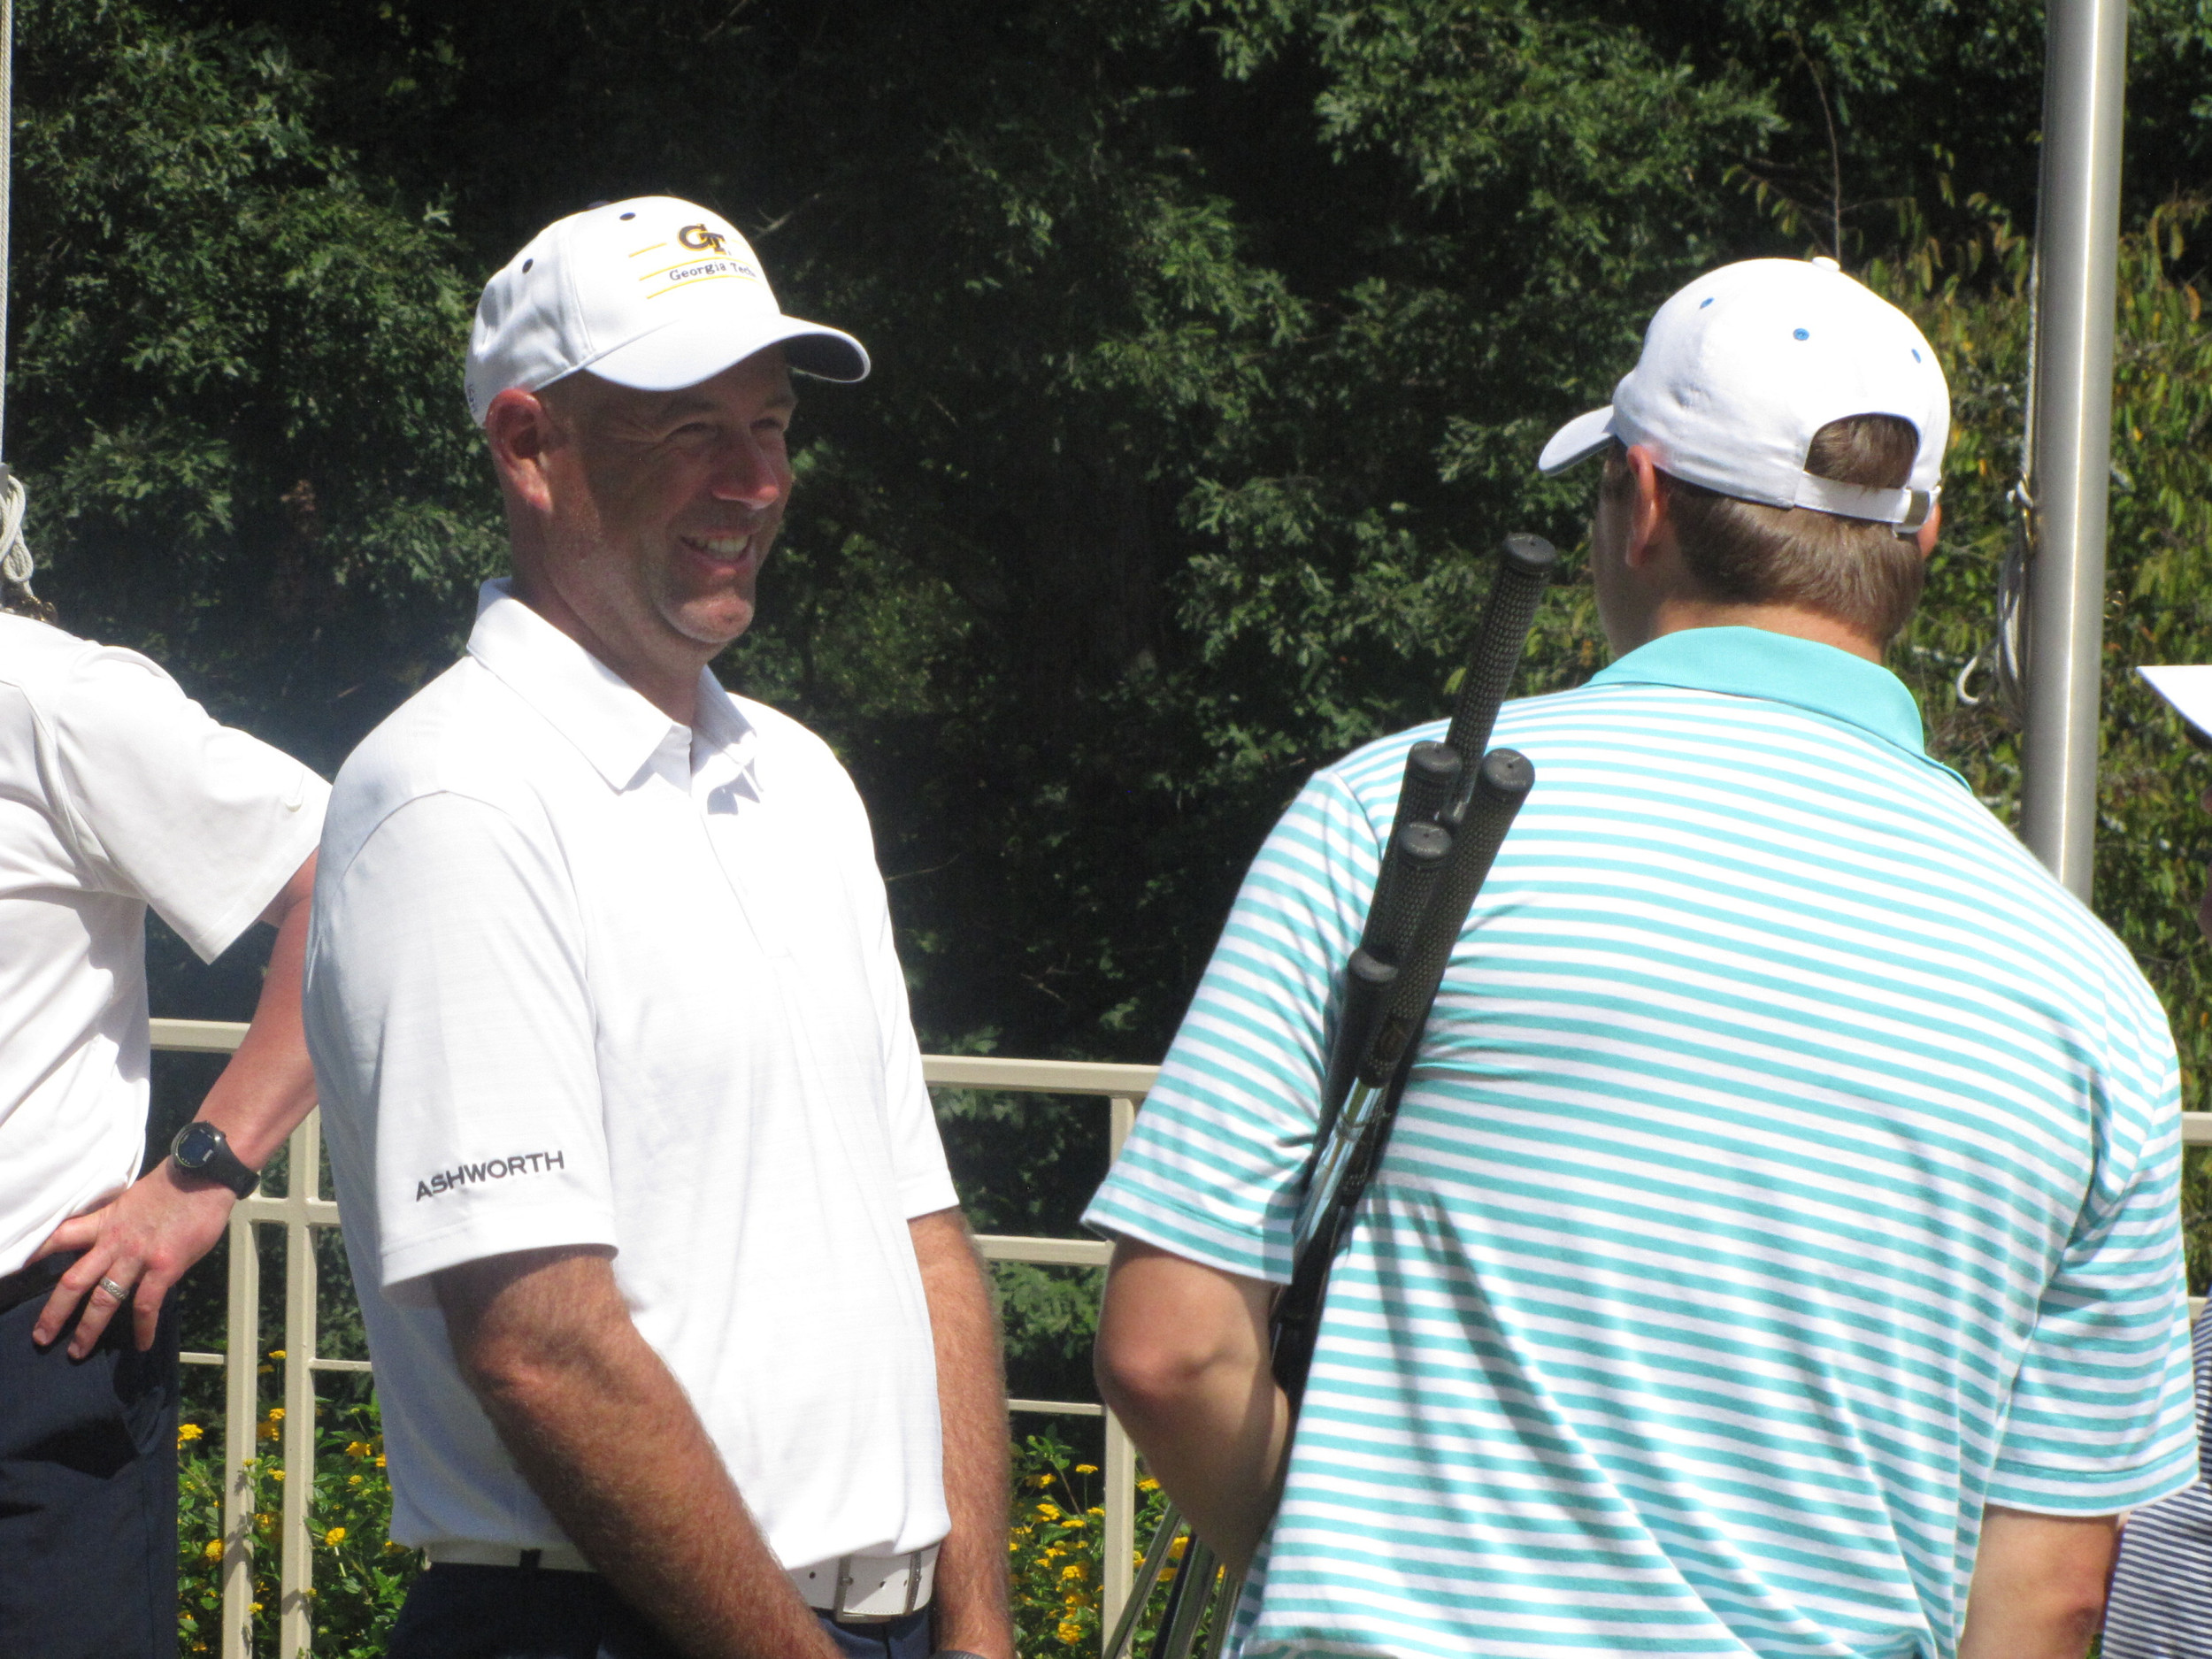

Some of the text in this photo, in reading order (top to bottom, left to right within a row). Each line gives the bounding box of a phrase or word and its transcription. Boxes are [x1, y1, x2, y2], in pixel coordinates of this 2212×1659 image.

[677, 224, 726, 255] GT
[669, 261, 727, 280] Georgia
[416, 1150, 565, 1202] ASHWORTH
